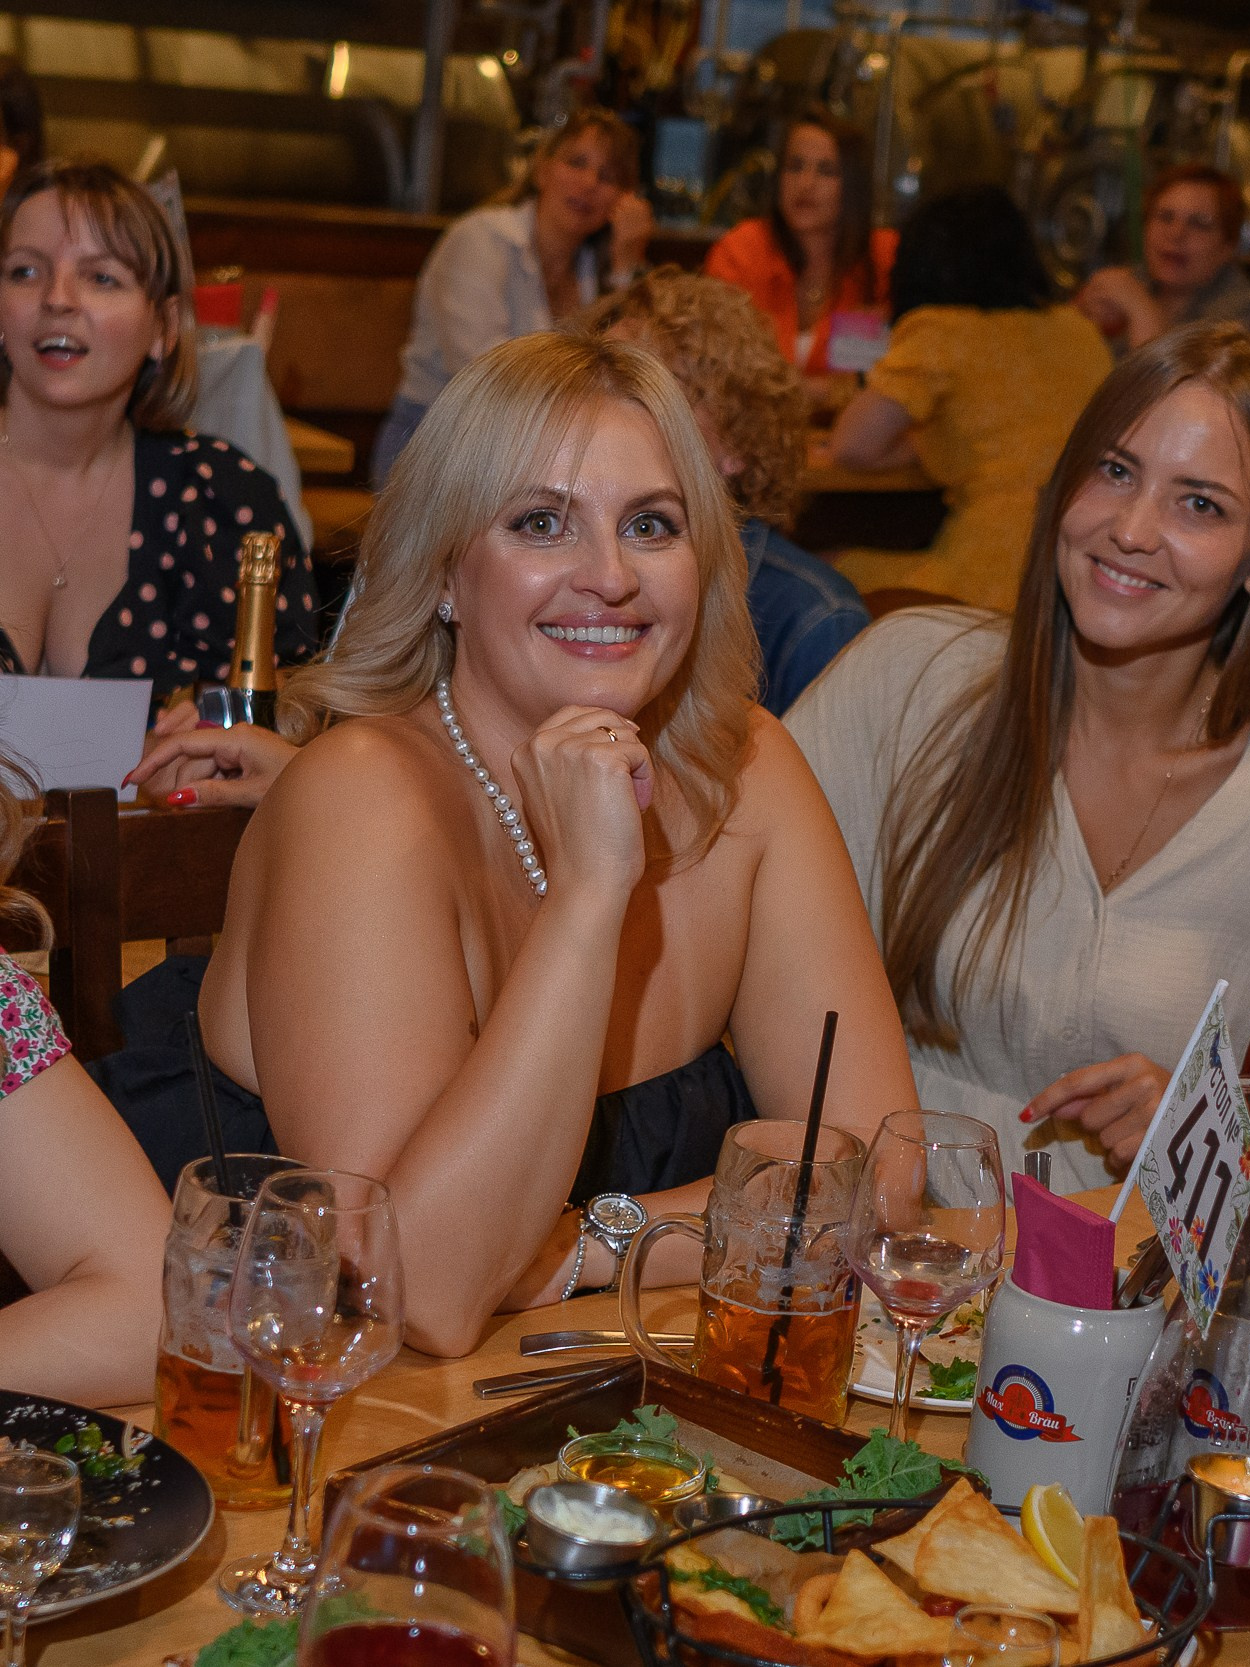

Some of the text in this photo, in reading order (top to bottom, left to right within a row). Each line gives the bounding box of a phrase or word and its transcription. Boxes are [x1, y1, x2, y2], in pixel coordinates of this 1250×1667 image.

[1210, 1067, 1232, 1124] СТОЛ
[1167, 1093, 1233, 1265] 411
[985, 1391, 1060, 1430] Max Bräu
